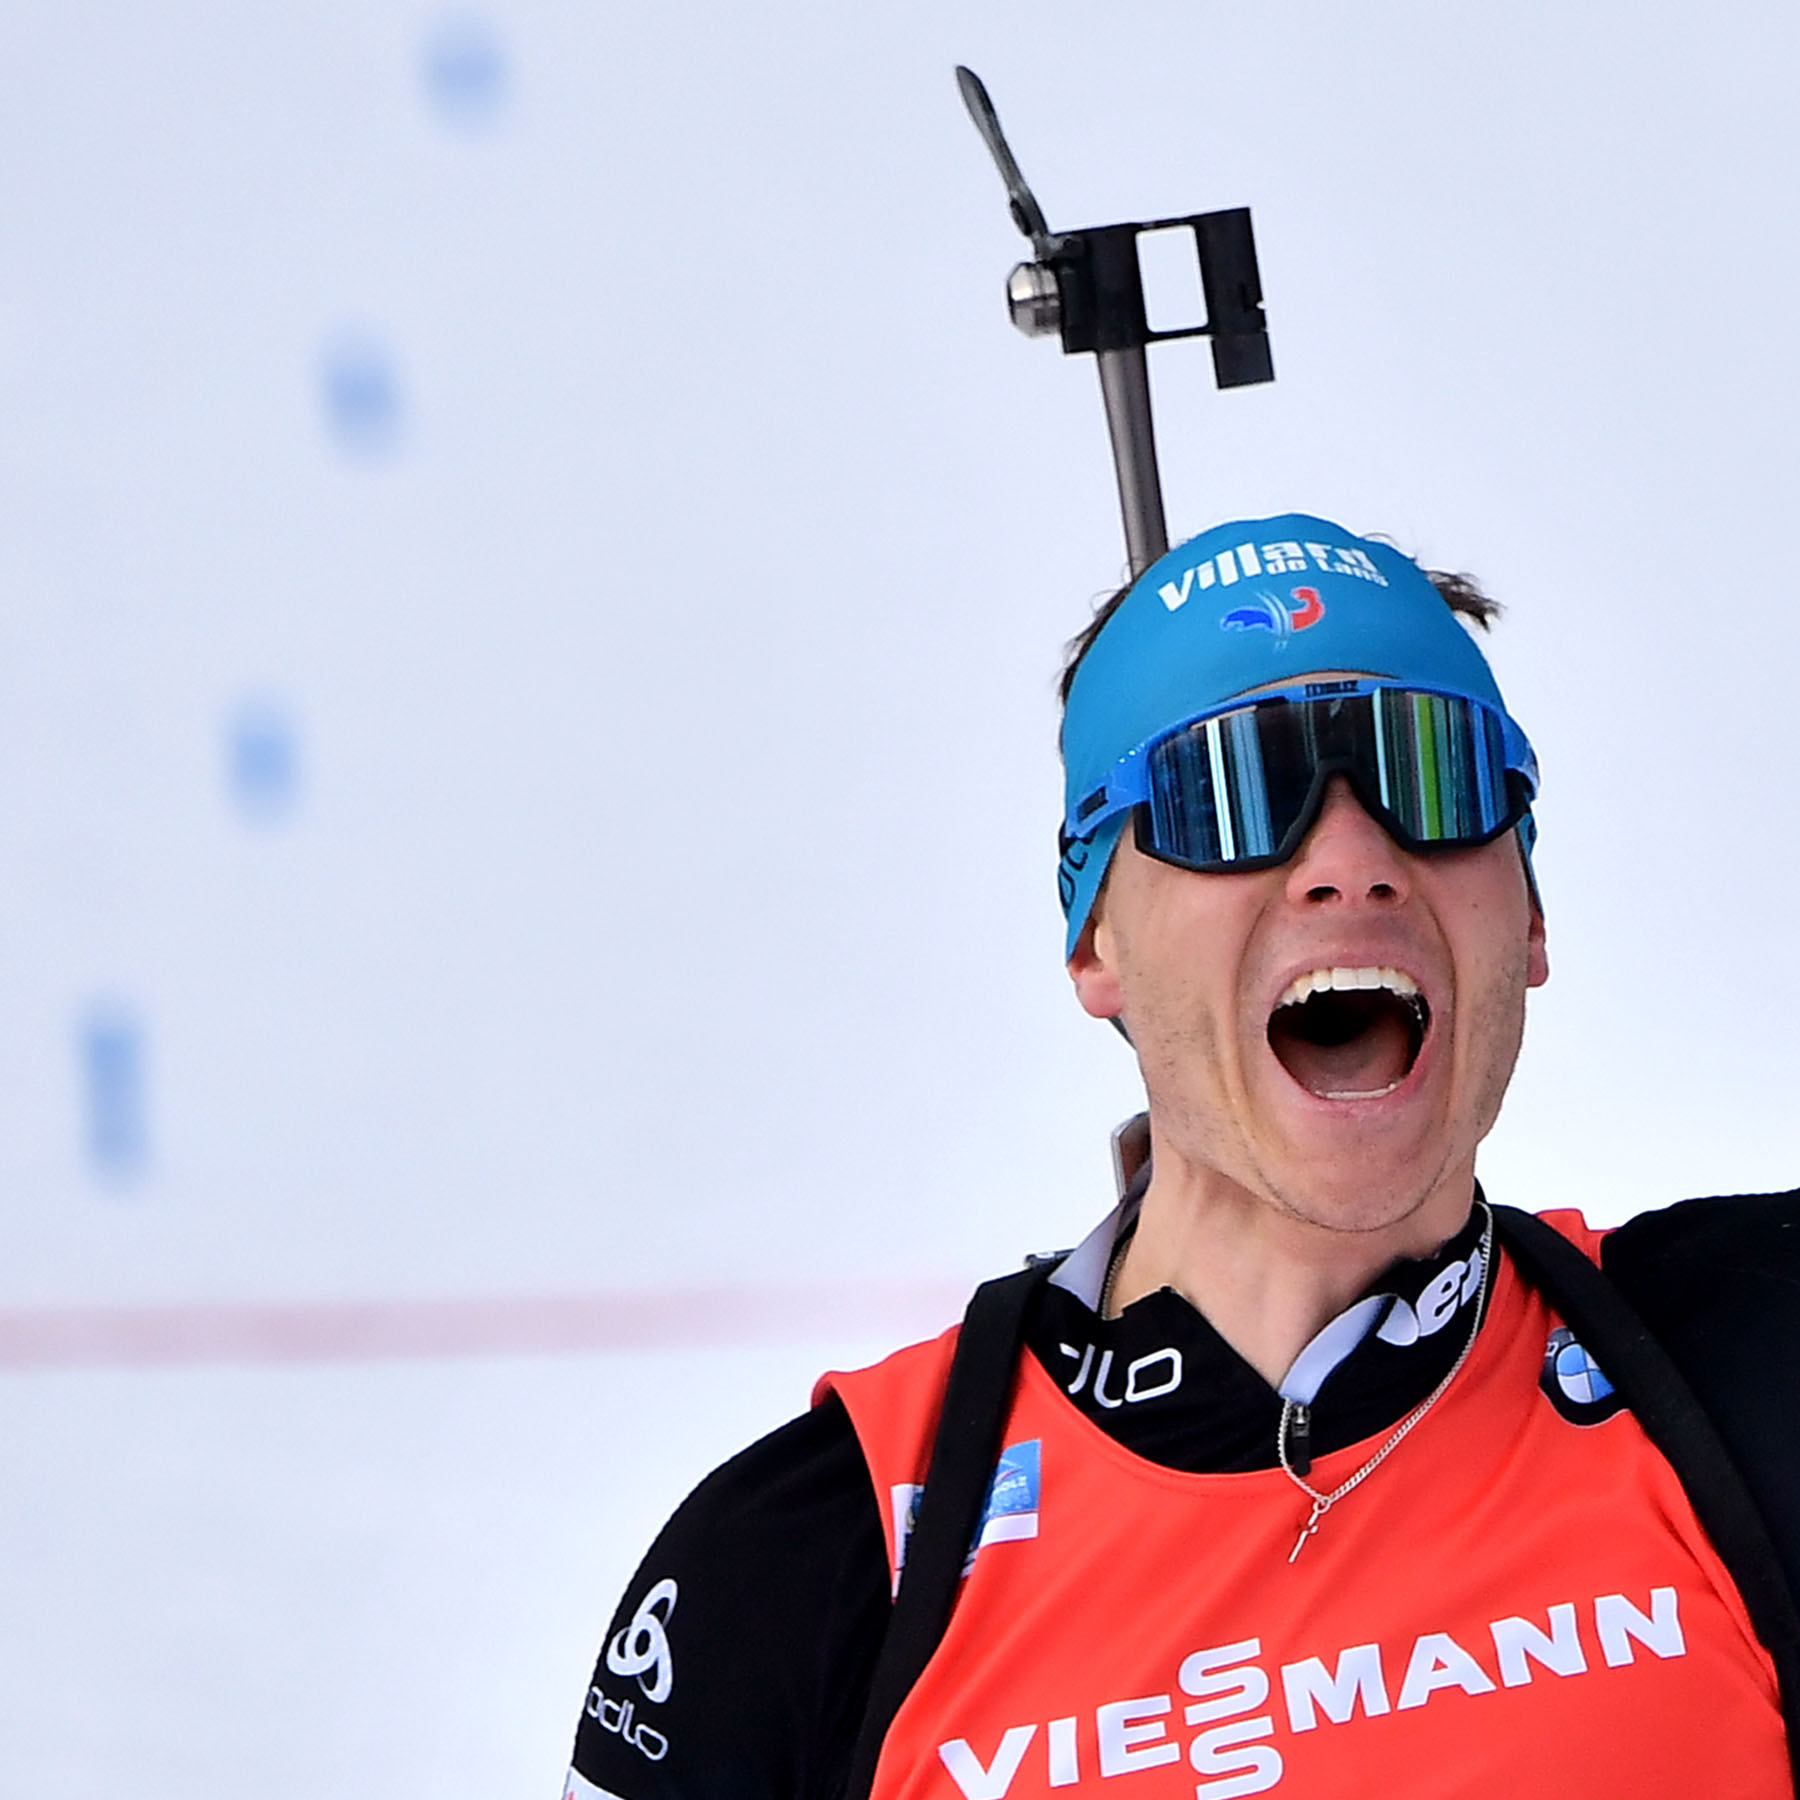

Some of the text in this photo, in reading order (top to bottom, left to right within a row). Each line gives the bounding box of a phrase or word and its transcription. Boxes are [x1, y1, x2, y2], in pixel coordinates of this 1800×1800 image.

[1157, 541, 1378, 612] Villard
[1266, 558, 1308, 575] de
[586, 1686, 669, 1761] odlo
[938, 1586, 1687, 1800] VIESSMANN
